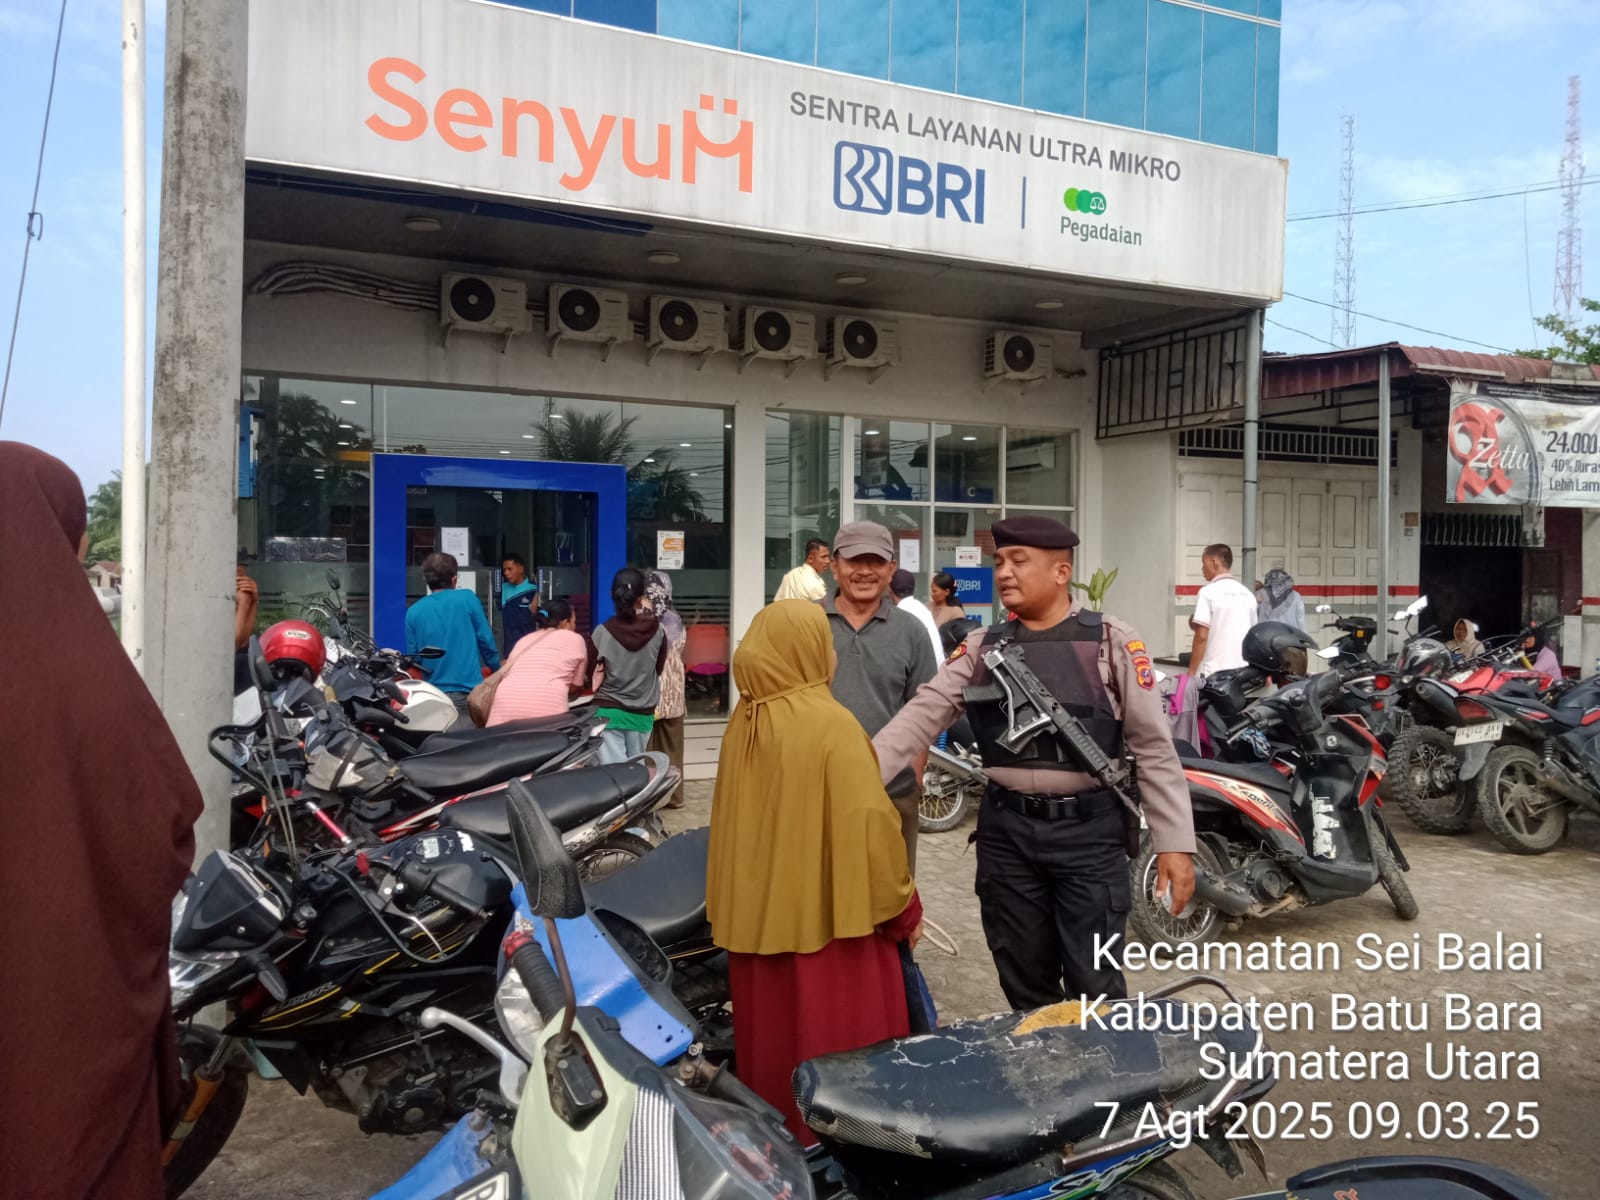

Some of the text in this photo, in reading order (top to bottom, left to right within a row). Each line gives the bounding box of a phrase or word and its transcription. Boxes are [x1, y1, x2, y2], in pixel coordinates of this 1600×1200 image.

[789, 91, 1181, 182] SENTRA LAYANAN ULTRA MIKRO
[897, 155, 985, 224] BRI
[1060, 216, 1142, 246] Pegadaian
[1468, 437, 1530, 470] Zetta
